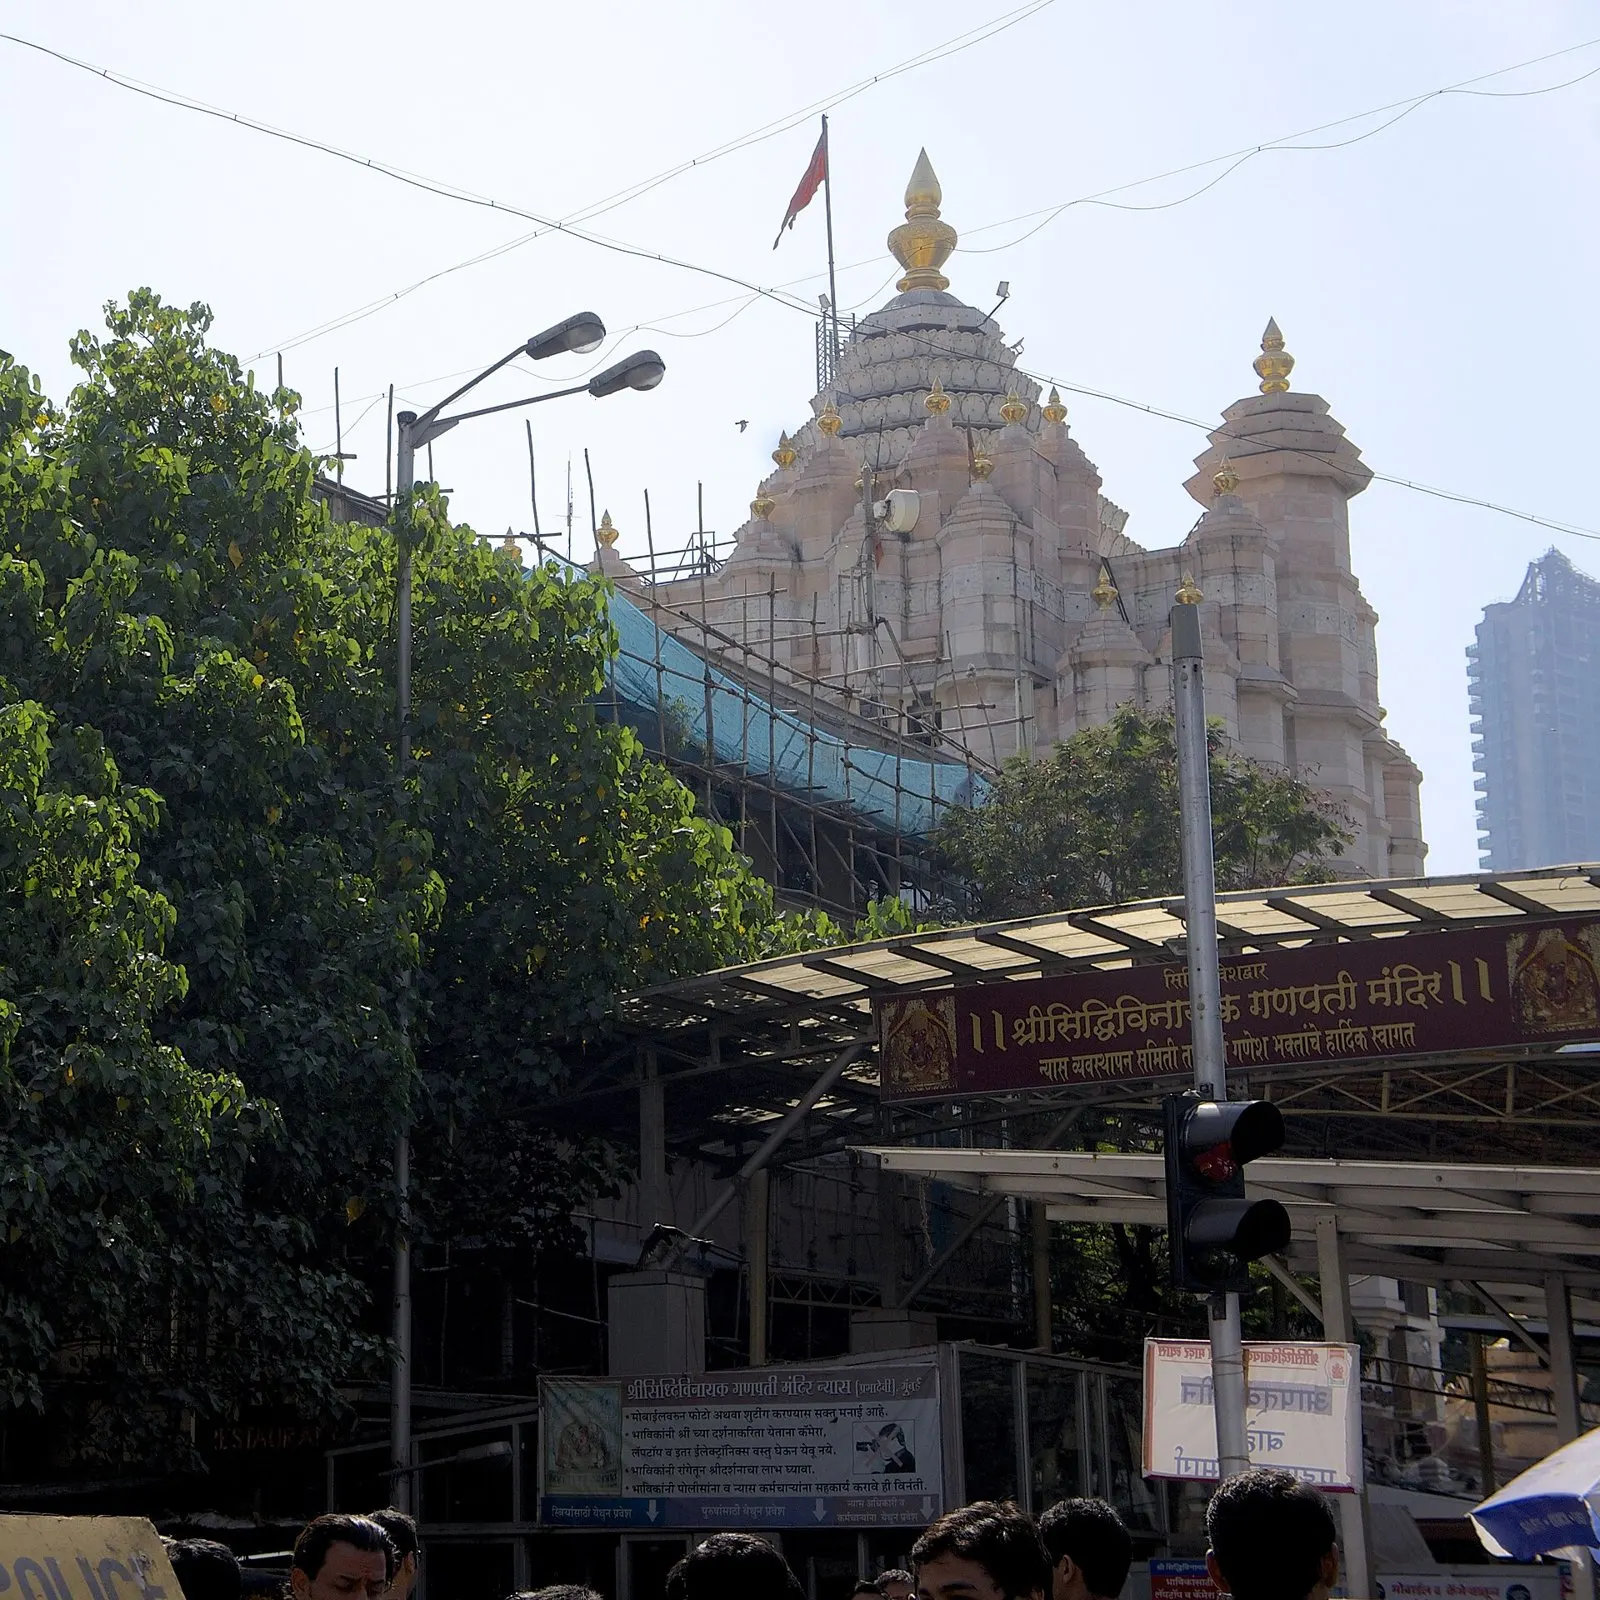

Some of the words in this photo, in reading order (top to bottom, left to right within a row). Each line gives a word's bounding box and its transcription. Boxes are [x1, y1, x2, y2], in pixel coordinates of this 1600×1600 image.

[1248, 970, 1358, 1020] गणपती
[1366, 963, 1444, 1010] मंदिर
[1038, 1056, 1070, 1082] न्यास
[1071, 1049, 1135, 1079] व्यवस्थापन
[1136, 1038, 1179, 1074] समिती
[1231, 1029, 1270, 1063] गणेश
[1272, 1023, 1323, 1059] भक्तांचे
[1325, 1019, 1369, 1057] हार्दिक
[1370, 1022, 1417, 1050] स्वागत
[732, 1375, 778, 1398] गणपती
[781, 1375, 814, 1397] मंदिर
[817, 1379, 852, 1396] न्यास
[688, 1407, 711, 1421] फोटो
[713, 1410, 740, 1421] अथवा
[771, 1408, 811, 1419] करण्यास
[839, 1404, 863, 1419] मनाई
[632, 1427, 675, 1440] भाविकांनी
[712, 1426, 764, 1440] दर्शनाकरिता
[767, 1424, 795, 1438] येताना
[665, 1448, 672, 1457] व
[675, 1447, 691, 1458] इतर
[774, 1443, 797, 1456] घेऊन
[632, 1464, 675, 1476] भाविकांनी
[762, 1464, 782, 1475] लाभ
[632, 1482, 675, 1495] भाविकांनी
[723, 1484, 730, 1493] व
[733, 1483, 756, 1494] न्यास
[815, 1479, 851, 1494] सहकार्य
[853, 1478, 878, 1492] करावे
[882, 1478, 892, 1493] ही
